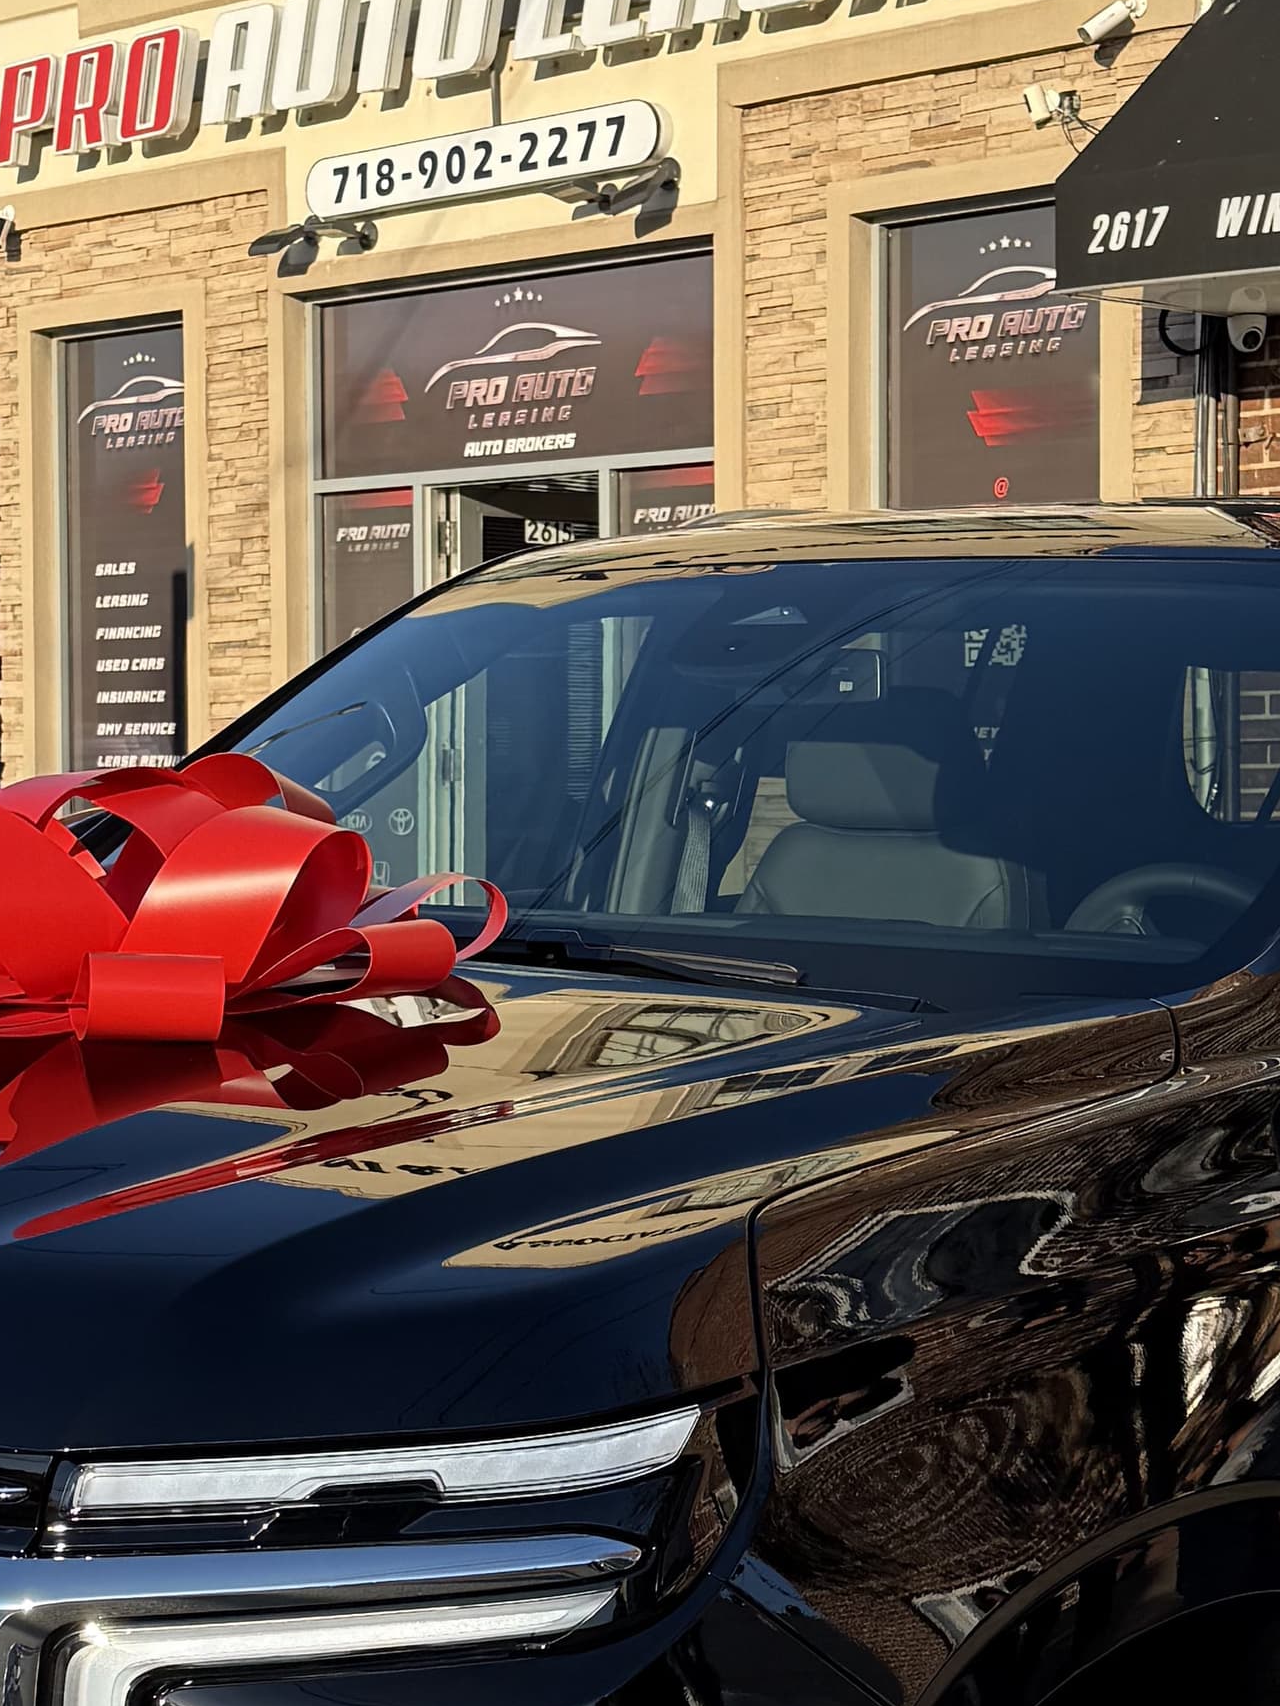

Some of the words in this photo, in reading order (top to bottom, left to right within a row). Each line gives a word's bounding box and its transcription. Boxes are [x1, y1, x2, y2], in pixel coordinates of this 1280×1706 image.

[330, 115, 628, 205] 718-902-2277
[1087, 205, 1170, 255] 2617
[926, 314, 995, 345] PRO
[996, 302, 1090, 338] AUTO
[949, 336, 1063, 363] LEASING
[446, 375, 510, 410] PRO
[511, 366, 598, 404] AUTO
[91, 412, 134, 436] PRO
[467, 404, 573, 431] LEASING
[463, 438, 504, 459] AUTO
[504, 432, 578, 455] BROKERS
[633, 508, 672, 525] PRO
[336, 526, 369, 543] PRO
[370, 522, 411, 539] AUTO
[526, 519, 572, 544] 2615
[95, 562, 136, 577] SALES
[95, 593, 149, 609] LEASING
[95, 625, 162, 641] FINANCING
[96, 659, 130, 673] USED
[131, 657, 166, 671] CARS
[96, 690, 167, 704] INSURANCE
[96, 722, 123, 736] DMV
[123, 721, 177, 736] SERVICE
[97, 755, 139, 768] LEASE
[140, 755, 185, 768] RETU
